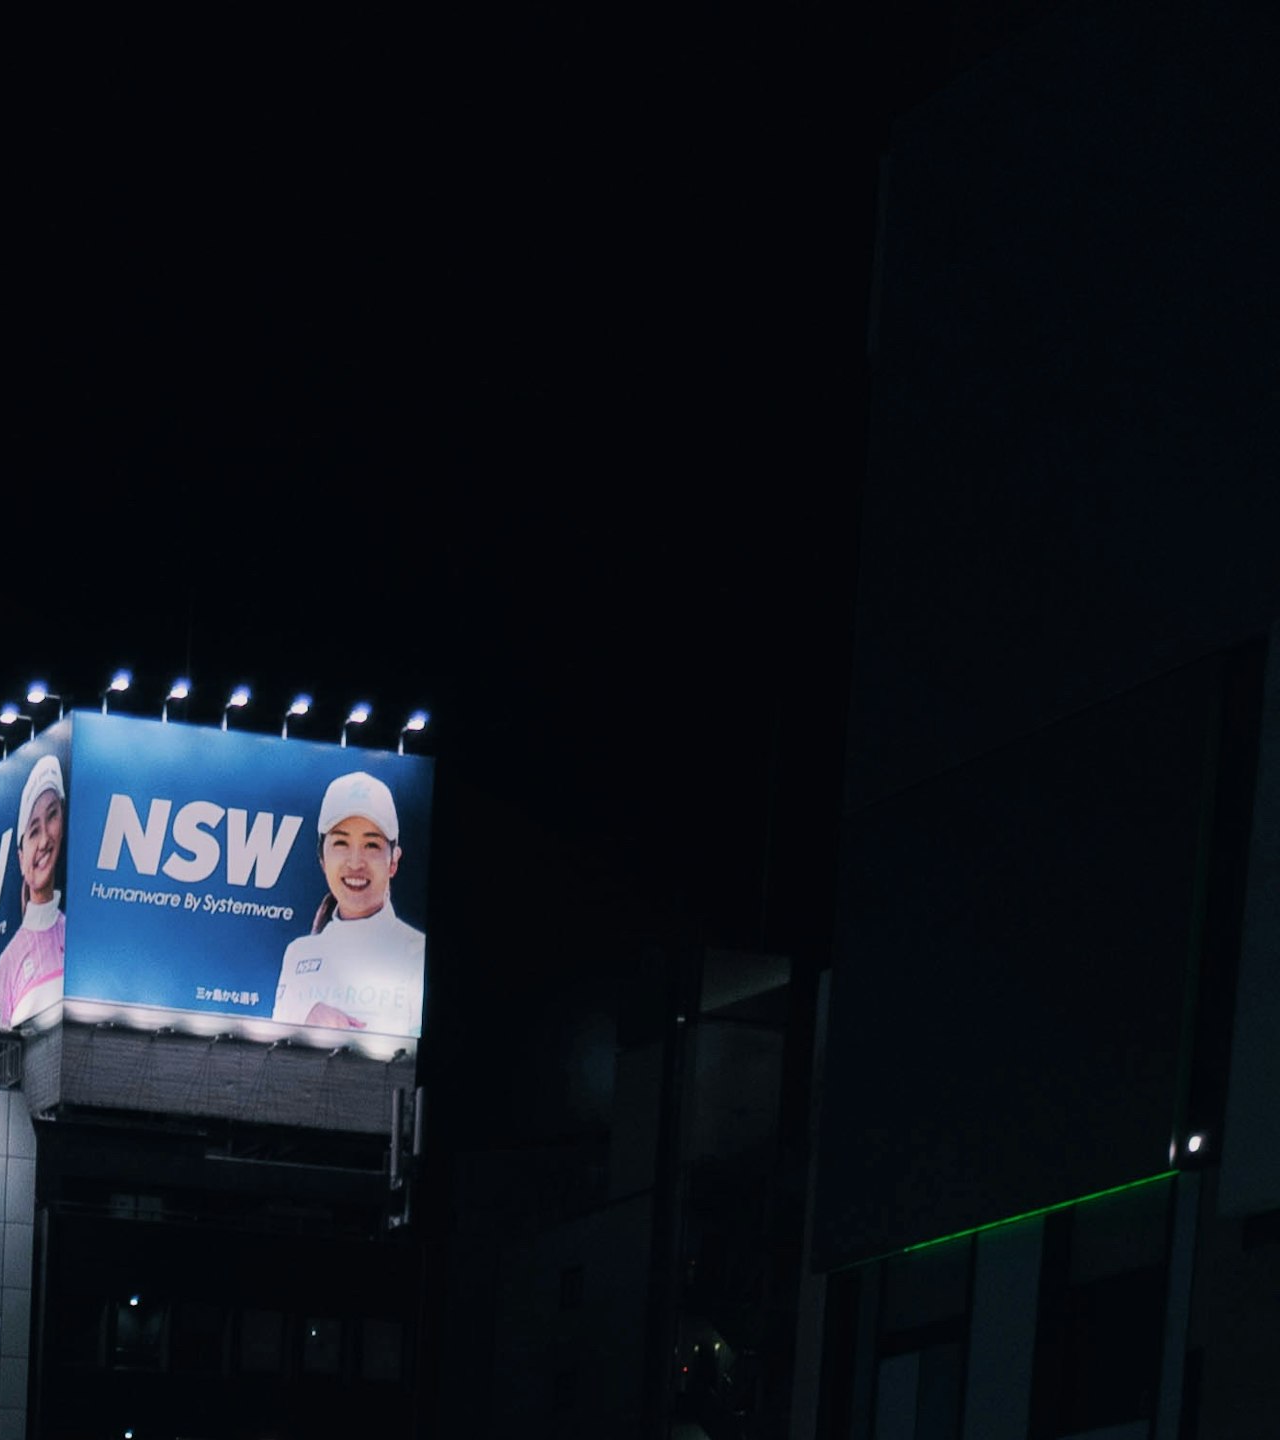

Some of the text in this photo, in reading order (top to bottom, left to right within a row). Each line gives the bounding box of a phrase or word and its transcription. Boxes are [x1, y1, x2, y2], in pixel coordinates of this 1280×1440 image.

[97, 794, 303, 889] NSW
[90, 881, 294, 921] Humanware By Systemware
